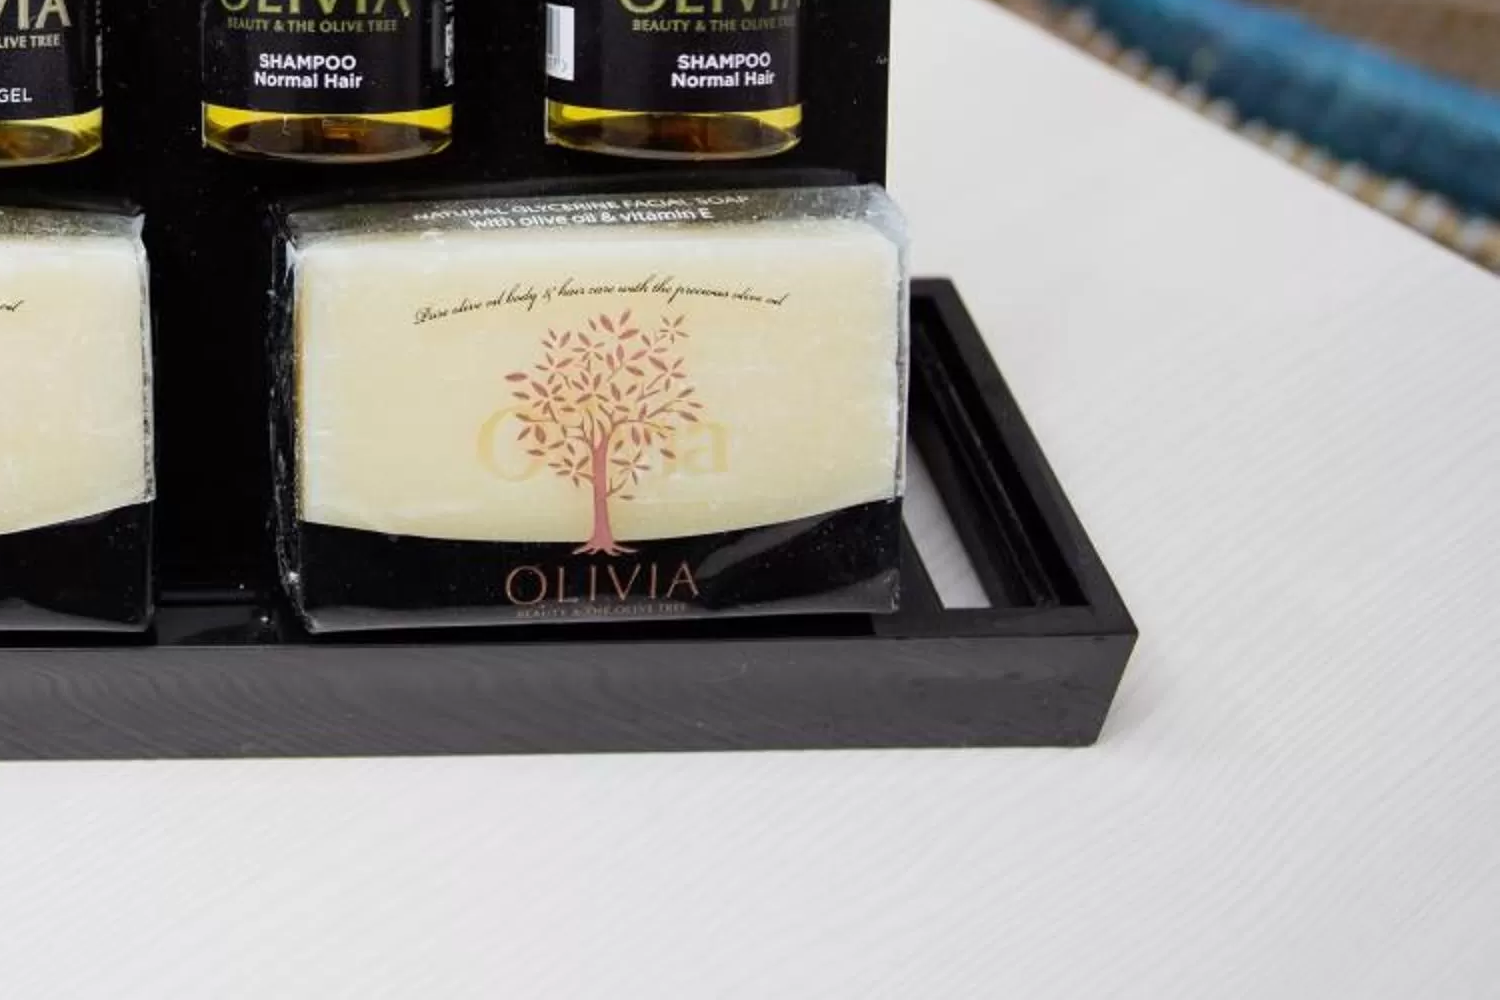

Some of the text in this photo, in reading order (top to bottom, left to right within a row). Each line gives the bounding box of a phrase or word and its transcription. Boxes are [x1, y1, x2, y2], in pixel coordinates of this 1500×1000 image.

[227, 16, 397, 33] BEAUTY & THE OLIVE TREE
[632, 18, 690, 32] BEAUTY
[695, 19, 706, 32] &
[710, 18, 737, 32] THE
[30, 33, 61, 48] TREE
[259, 53, 357, 71] SHAMPOO
[677, 51, 772, 71] SHAMPOO
[254, 71, 363, 89] Normal Hair
[671, 69, 776, 88] Normal Hair
[511, 200, 620, 214] GLYCERINE
[621, 198, 693, 209] FACIAL
[469, 206, 715, 230] with olive oil & vitamin E
[0, 299, 25, 312] oil
[412, 306, 449, 325] Pure
[451, 298, 483, 314] olive
[485, 288, 507, 307] oil
[505, 282, 538, 312] body
[557, 275, 585, 297] hair
[588, 285, 618, 294] care
[617, 273, 657, 293] with
[651, 275, 675, 293] the
[667, 285, 729, 305] precious
[731, 286, 762, 302] olive
[765, 291, 791, 306] oil
[504, 561, 700, 606] OLIVIA
